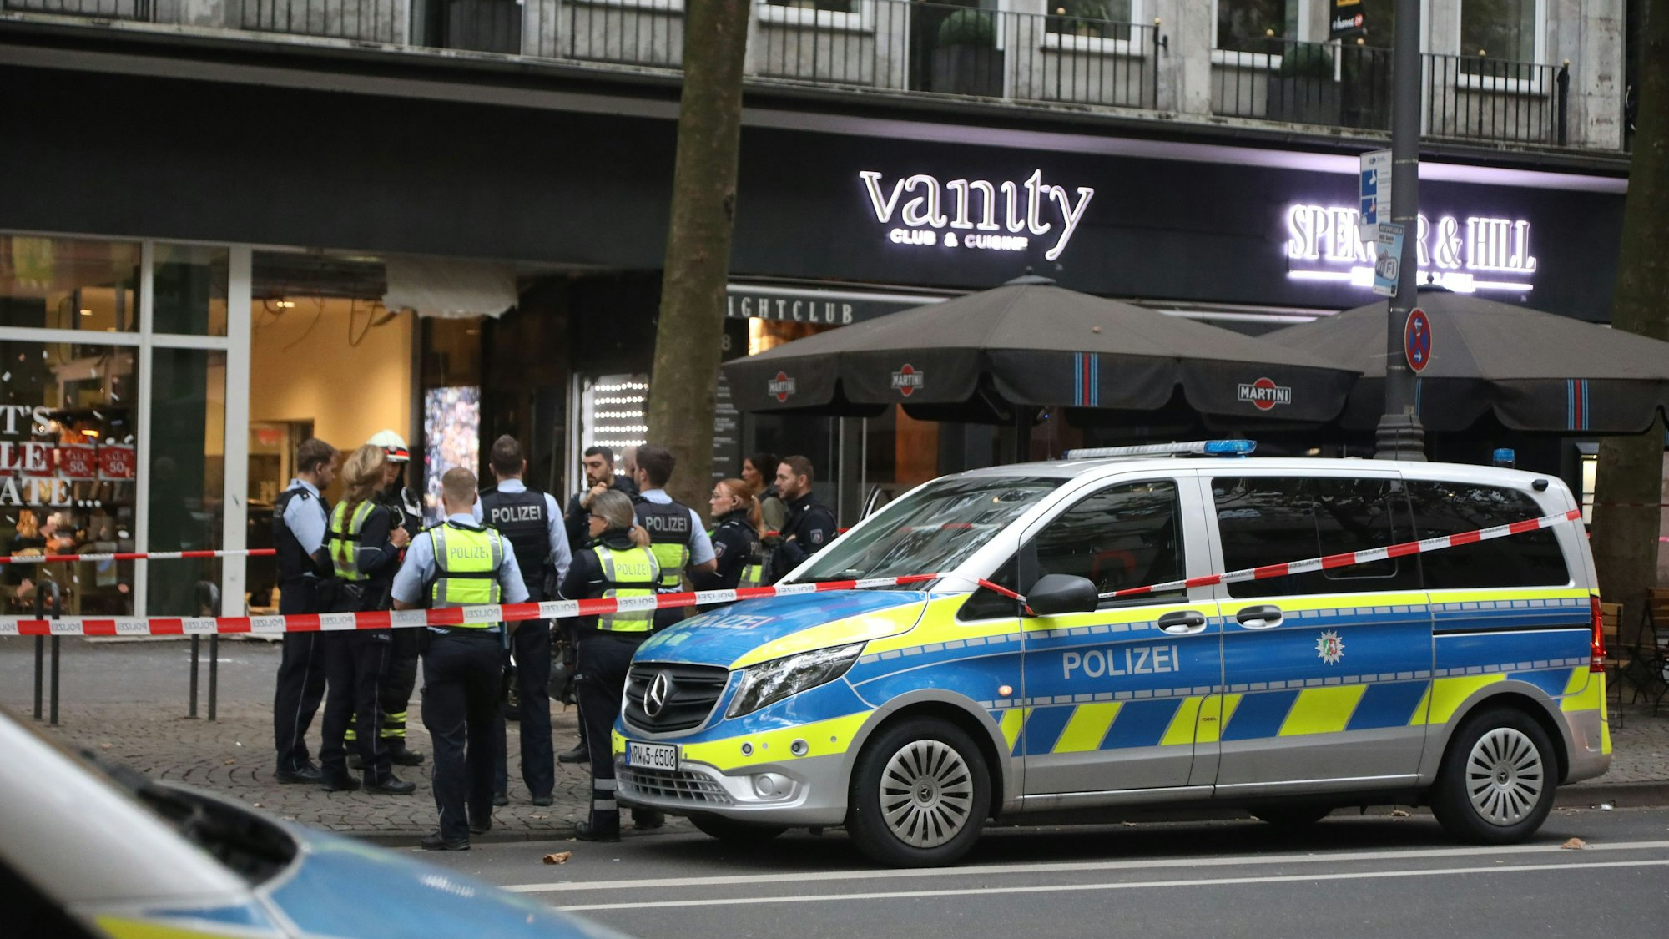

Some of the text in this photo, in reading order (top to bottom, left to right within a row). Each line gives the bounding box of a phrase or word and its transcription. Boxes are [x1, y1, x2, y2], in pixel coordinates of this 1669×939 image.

[859, 168, 1095, 261] vanity
[889, 228, 937, 246] CLUB
[1287, 204, 1537, 272] SPENR & HILL
[727, 295, 854, 324] IGHTCLUB
[768, 380, 795, 394] MARTINI
[892, 374, 922, 388] MARTINI
[1240, 382, 1290, 402] MARTINI
[491, 505, 542, 523] POLIZEI
[645, 516, 688, 532] POLIZEI
[450, 547, 490, 559] POLIZEI
[616, 563, 650, 576] POLIZEI
[1062, 644, 1180, 680] POLIZEI
